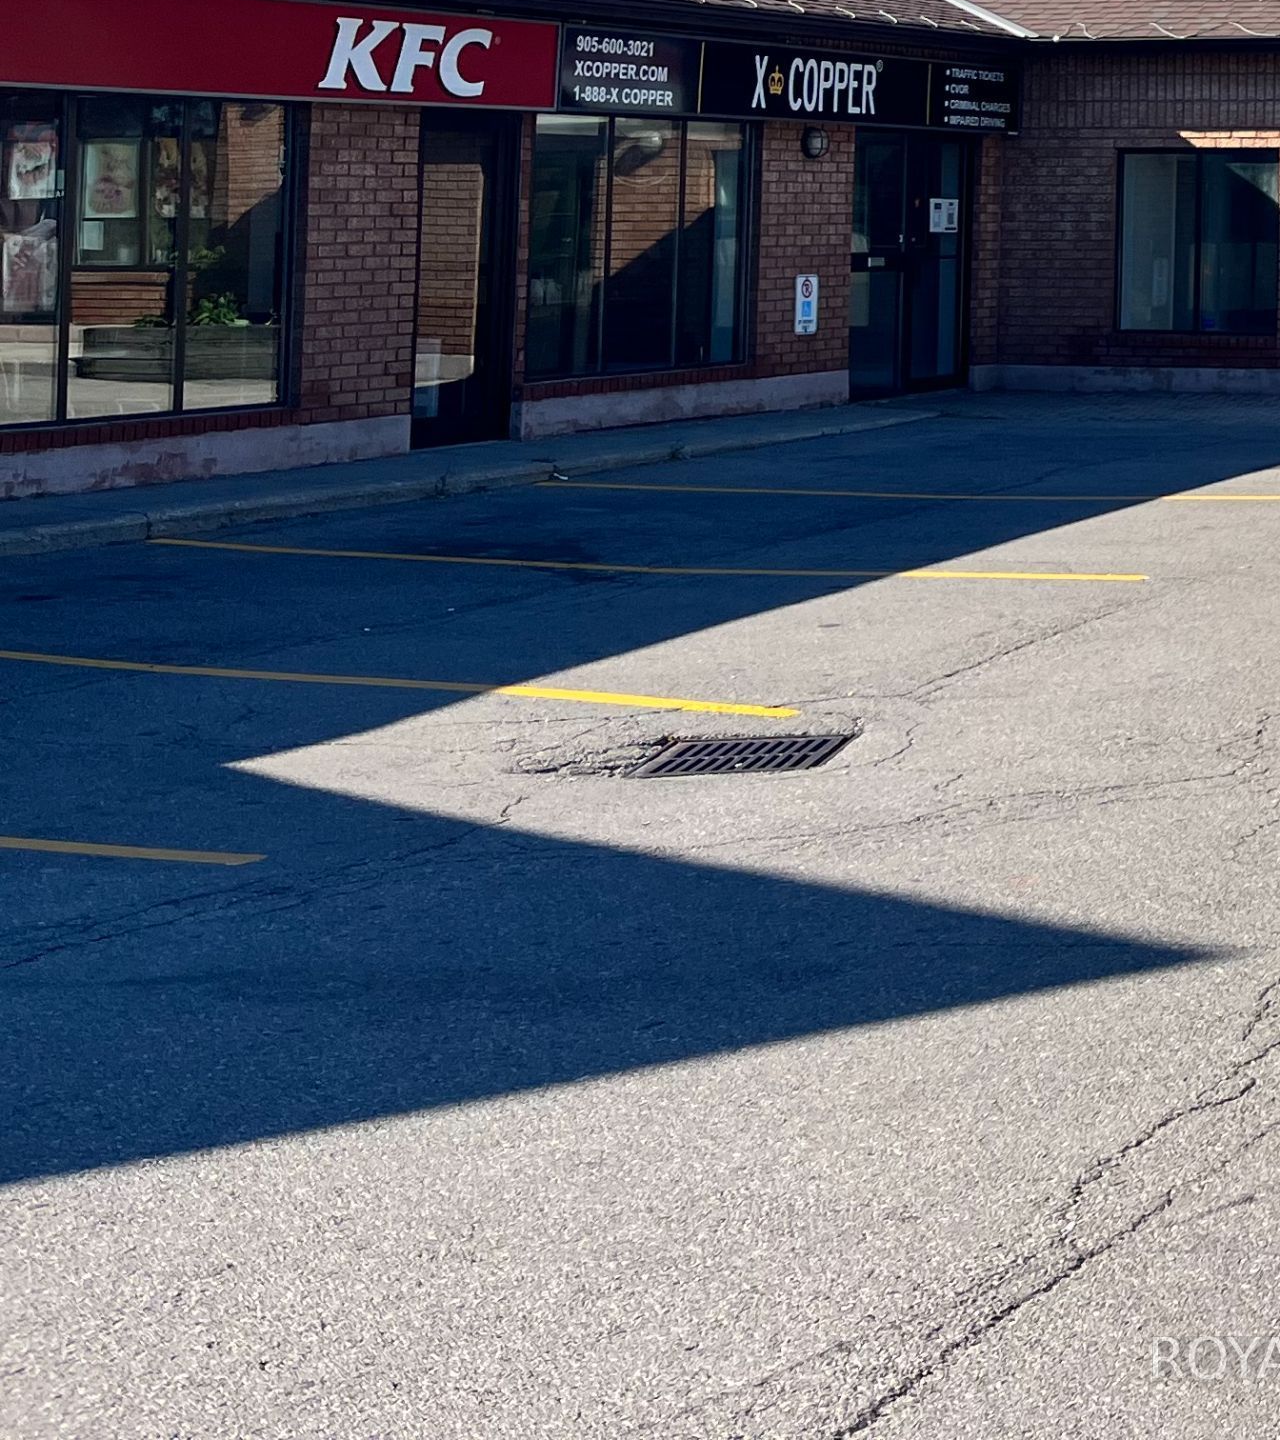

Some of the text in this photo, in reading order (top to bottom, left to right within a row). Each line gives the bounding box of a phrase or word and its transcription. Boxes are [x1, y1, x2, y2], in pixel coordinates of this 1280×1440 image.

[318, 17, 493, 97] KFC
[577, 35, 654, 57] 905-600-3021
[574, 60, 668, 82] XCOPPER.COM
[952, 68, 1004, 82] TRAFFIC TICKETS
[573, 85, 673, 106] 1-888-X COPPER
[751, 55, 877, 115] X COPPER
[950, 84, 969, 94] CVOR
